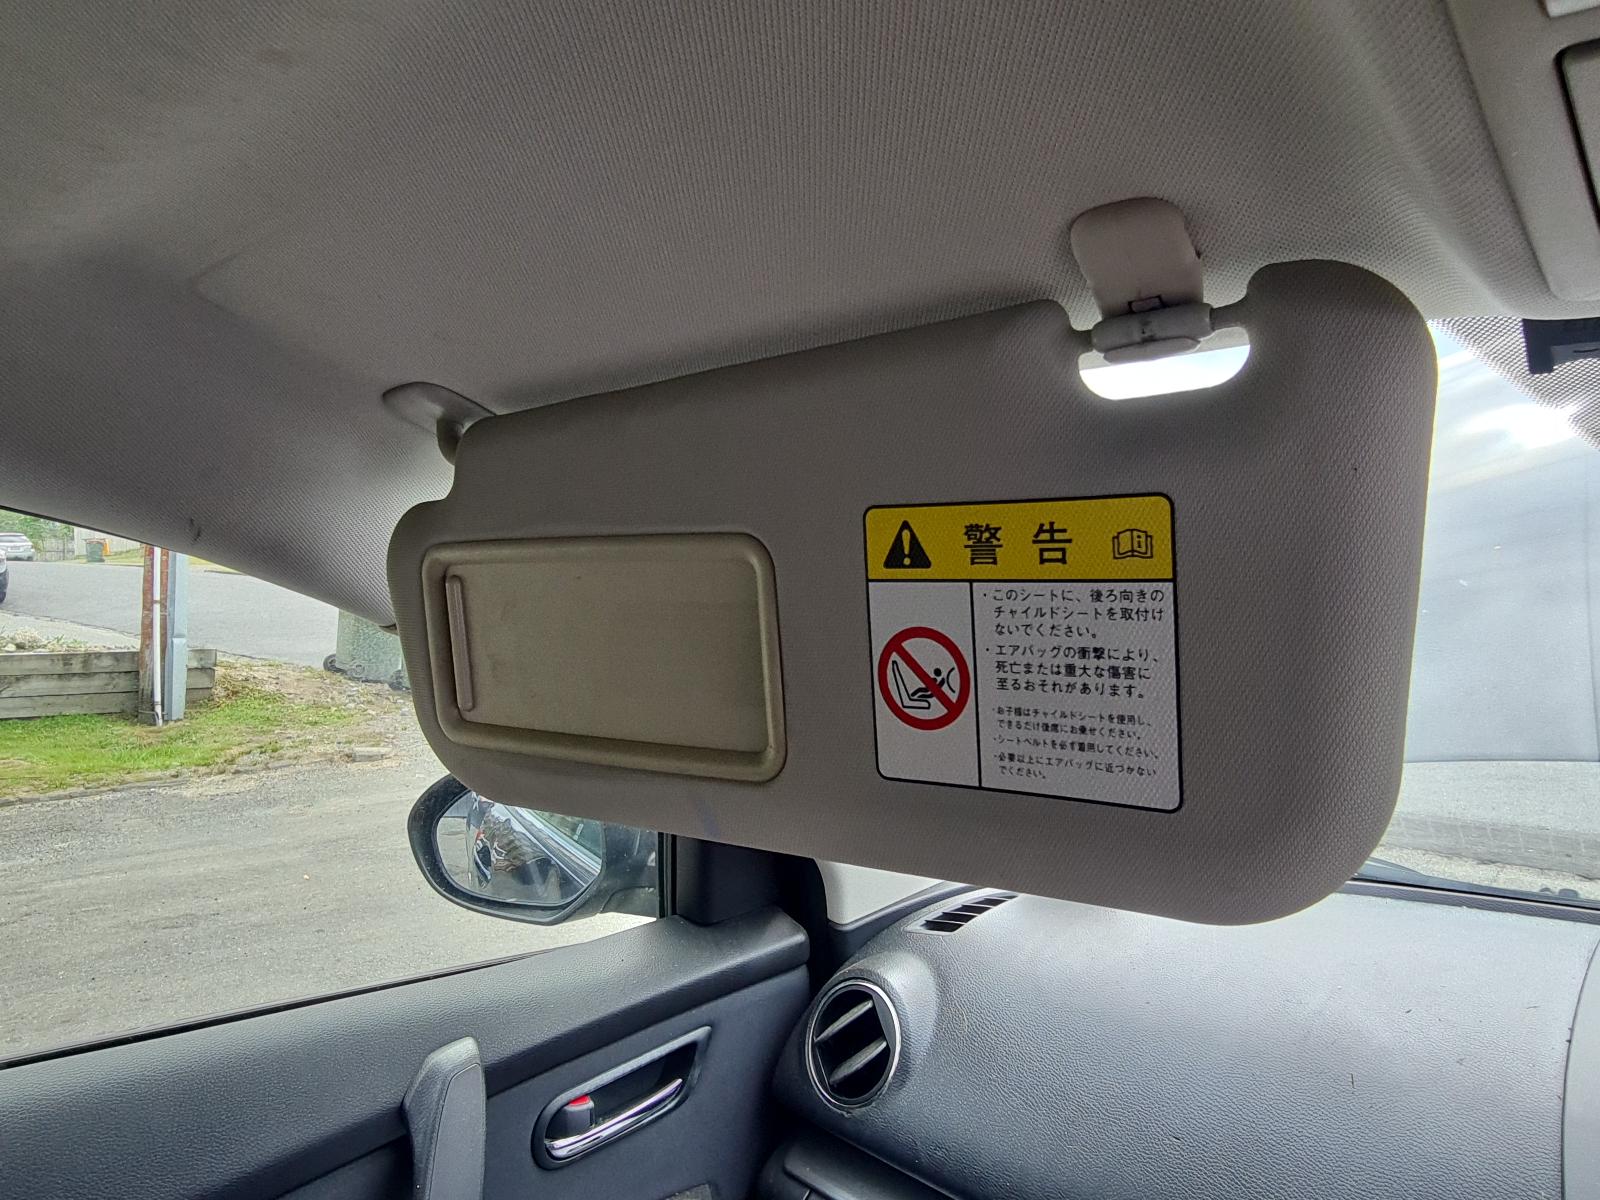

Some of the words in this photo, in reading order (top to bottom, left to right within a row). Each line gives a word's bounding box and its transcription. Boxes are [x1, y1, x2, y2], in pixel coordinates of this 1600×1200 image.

[964, 521, 1073, 566] 警告
[993, 588, 1165, 603] このシートに、後ろ向きの
[993, 606, 1164, 622] チャイルドシートを取付け
[995, 623, 1097, 639] ないでください。
[995, 644, 1158, 663] エアバッグの衝撃により、
[995, 660, 1151, 680] 死亡または重大な傷害に
[996, 677, 1144, 699] 至るおそれがあります。
